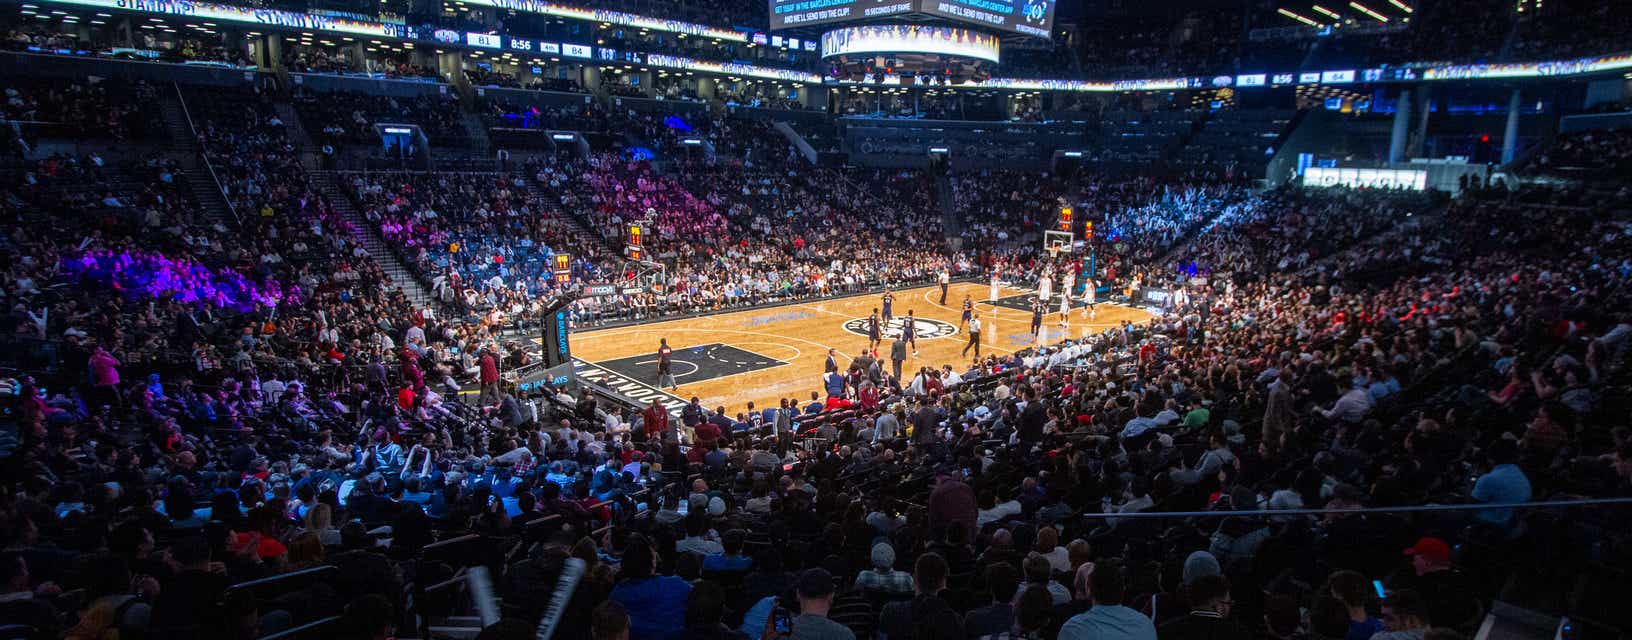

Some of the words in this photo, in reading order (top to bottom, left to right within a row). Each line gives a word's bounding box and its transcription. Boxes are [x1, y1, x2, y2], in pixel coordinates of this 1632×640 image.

[254, 8, 303, 28] STAND
[784, 15, 793, 24] AND
[806, 12, 818, 21] SEND
[818, 10, 828, 19] YOU
[828, 9, 837, 17] THE
[938, 3, 949, 12] AND
[963, 8, 975, 18] SEND
[984, 13, 993, 22] THE
[478, 37, 490, 45] 81
[511, 39, 531, 50] 8:56
[572, 46, 583, 55] 84
[558, 320, 568, 354] BARCLAYS
